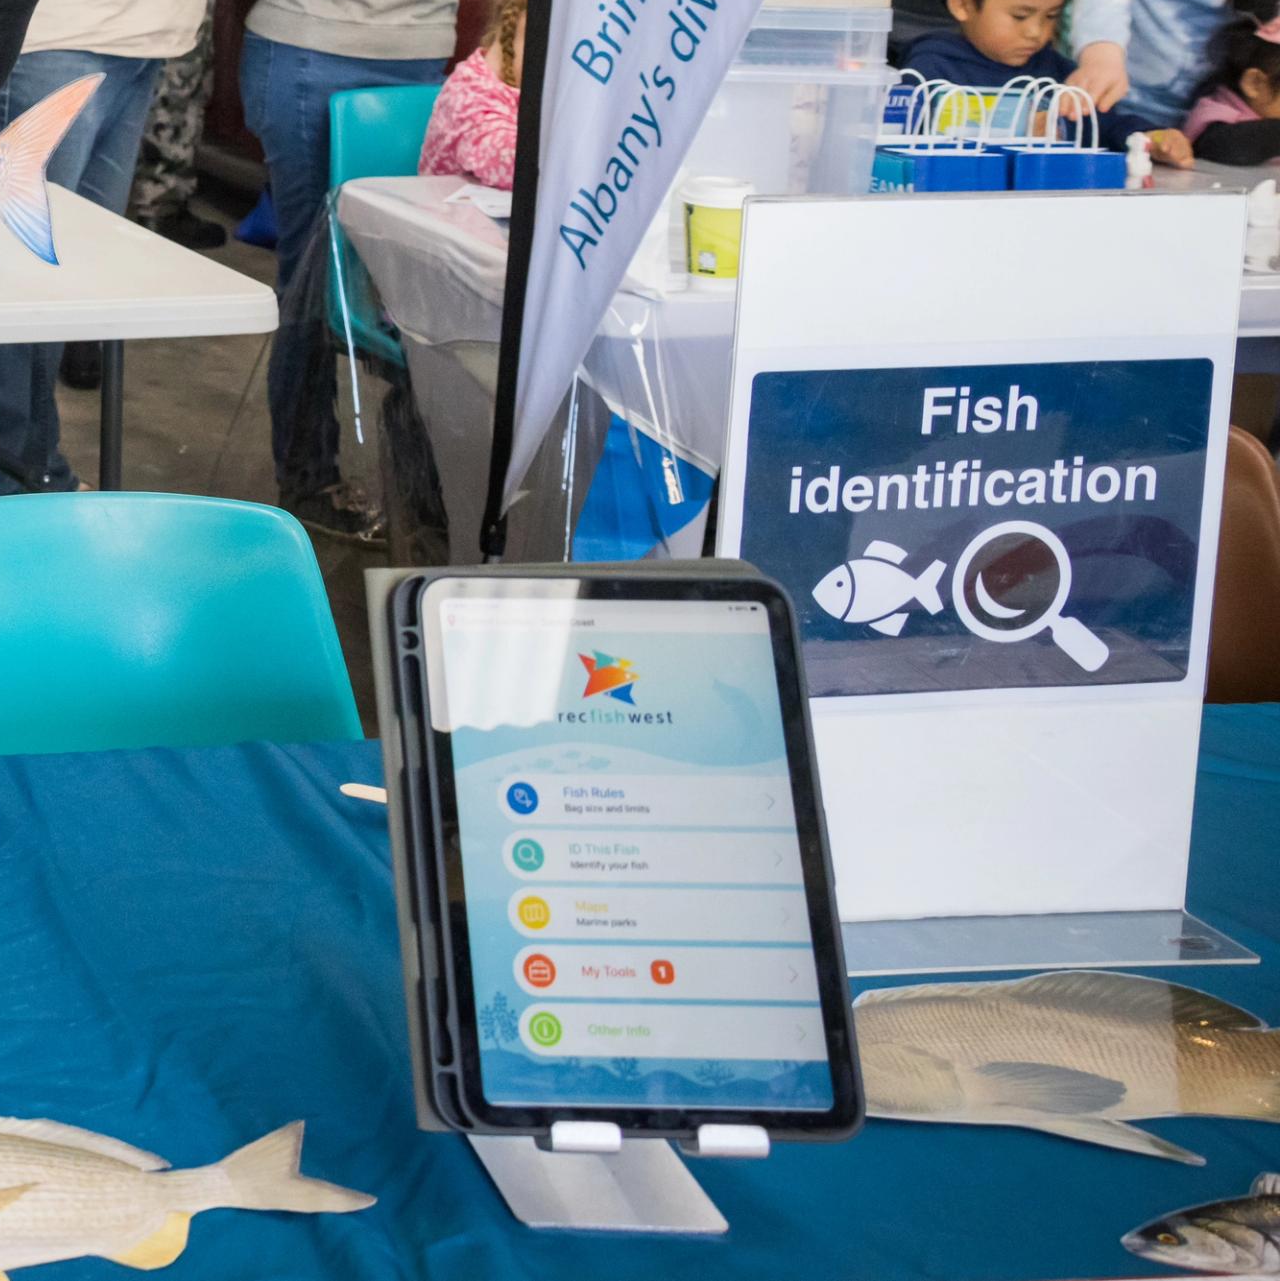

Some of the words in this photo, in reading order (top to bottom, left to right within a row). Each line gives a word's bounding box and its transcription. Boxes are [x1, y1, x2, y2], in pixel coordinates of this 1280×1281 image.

[558, 61, 676, 271] Albany's
[921, 384, 1039, 435] Fish
[788, 455, 1158, 514] identification
[558, 709, 673, 724] recfishwest
[563, 787, 588, 799] Fish
[591, 787, 625, 799] Rules
[564, 804, 583, 815] Bag
[586, 804, 603, 813] size
[605, 804, 622, 813] and
[624, 804, 650, 814] limits
[569, 843, 582, 856] ID
[586, 843, 611, 856] This
[614, 843, 640, 856] Fish
[570, 860, 606, 871] Identify
[608, 862, 628, 872] your
[631, 860, 649, 870] fish
[575, 901, 608, 914] Maps
[576, 917, 608, 927] Marine
[611, 917, 637, 928] parks
[582, 965, 601, 978] My
[604, 965, 637, 978] Tools
[659, 966, 667, 978] 1
[588, 1024, 623, 1037] Other
[627, 1024, 651, 1037] Info
